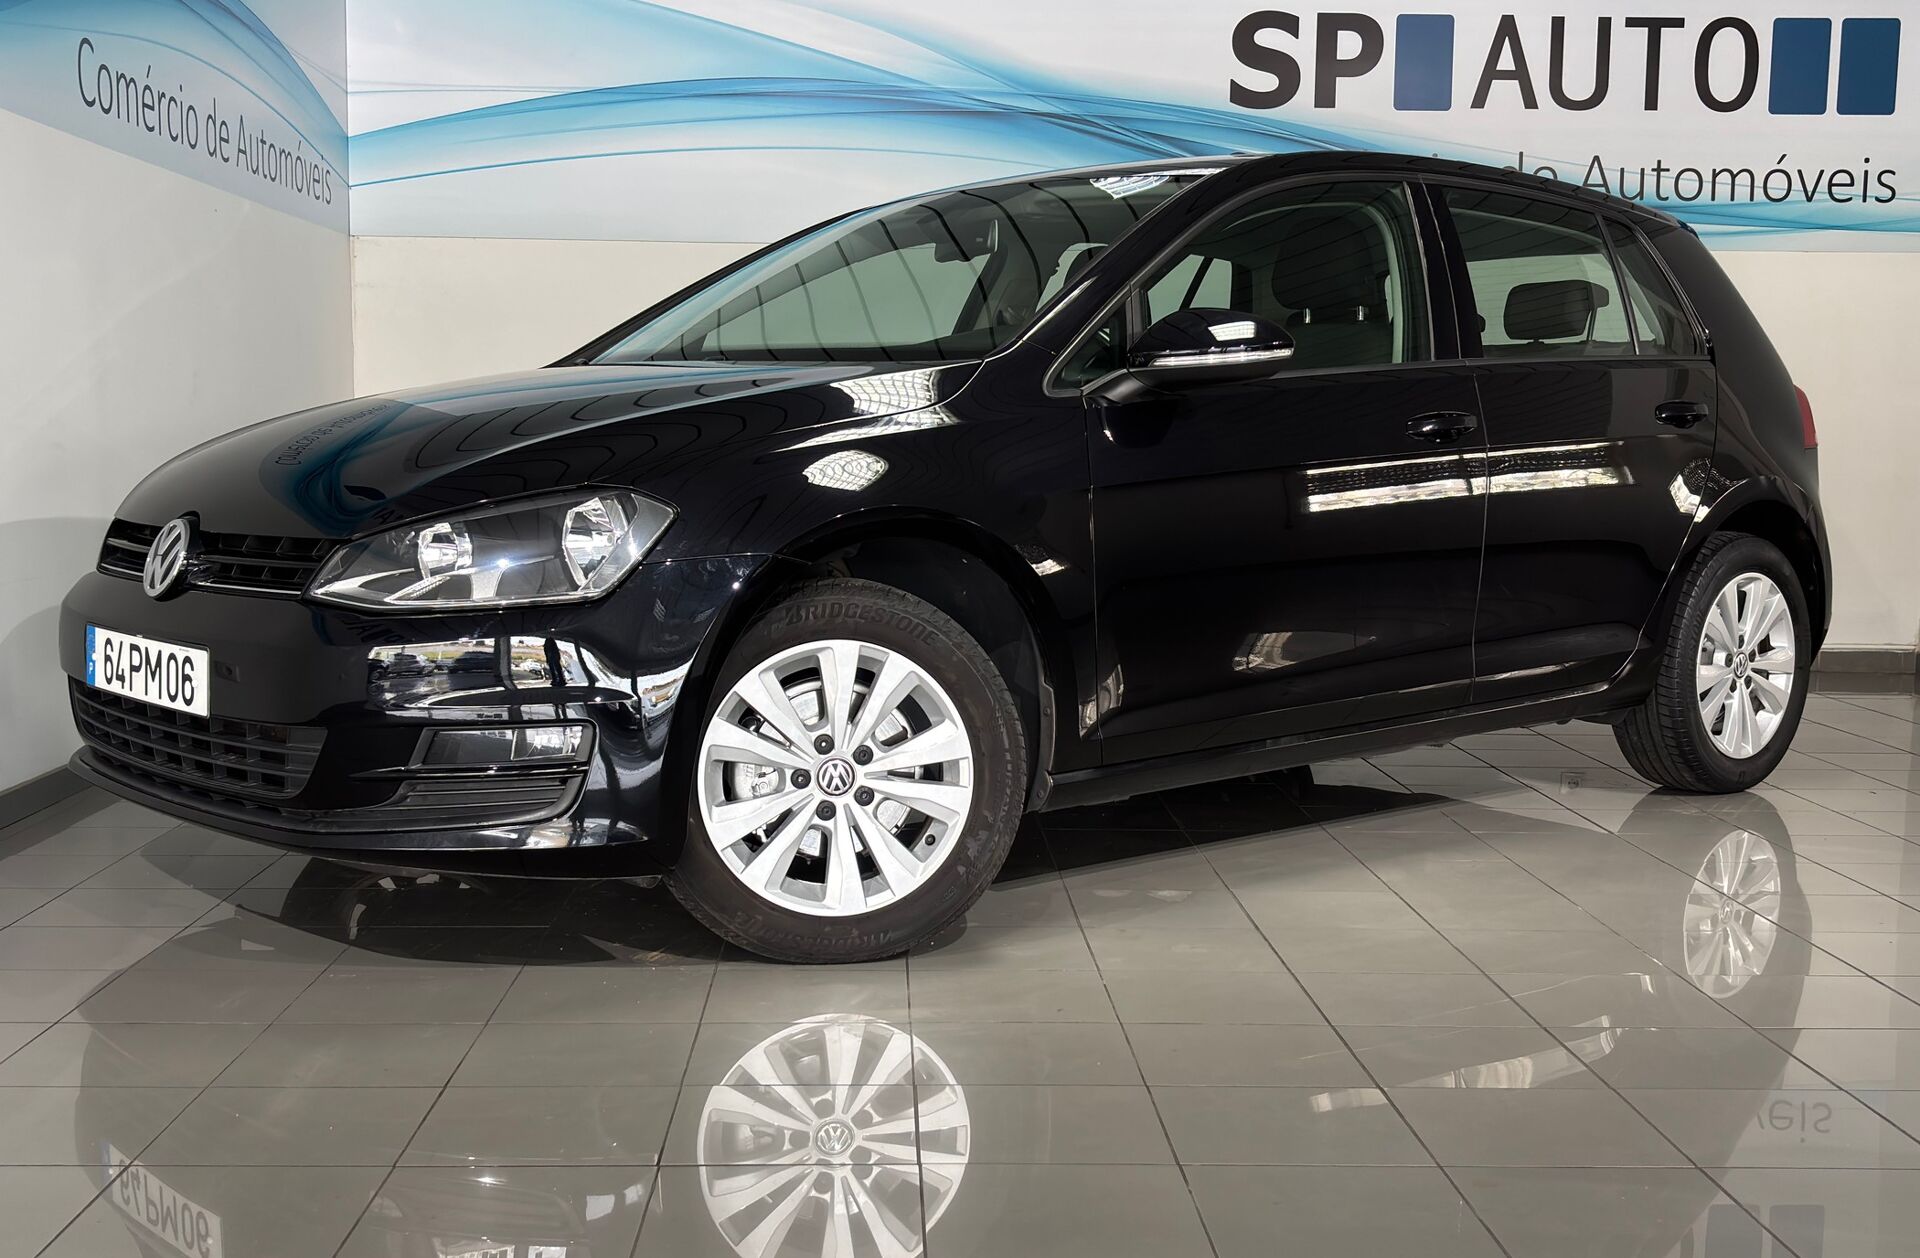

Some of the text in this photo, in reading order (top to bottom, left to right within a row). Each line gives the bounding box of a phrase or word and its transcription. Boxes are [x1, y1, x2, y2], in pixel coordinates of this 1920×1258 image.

[1229, 9, 1760, 113] SP AUTO
[76, 37, 332, 205] Comércio de Automóveis
[1582, 154, 1898, 204] Automóveis
[104, 637, 195, 706] 64PM06
